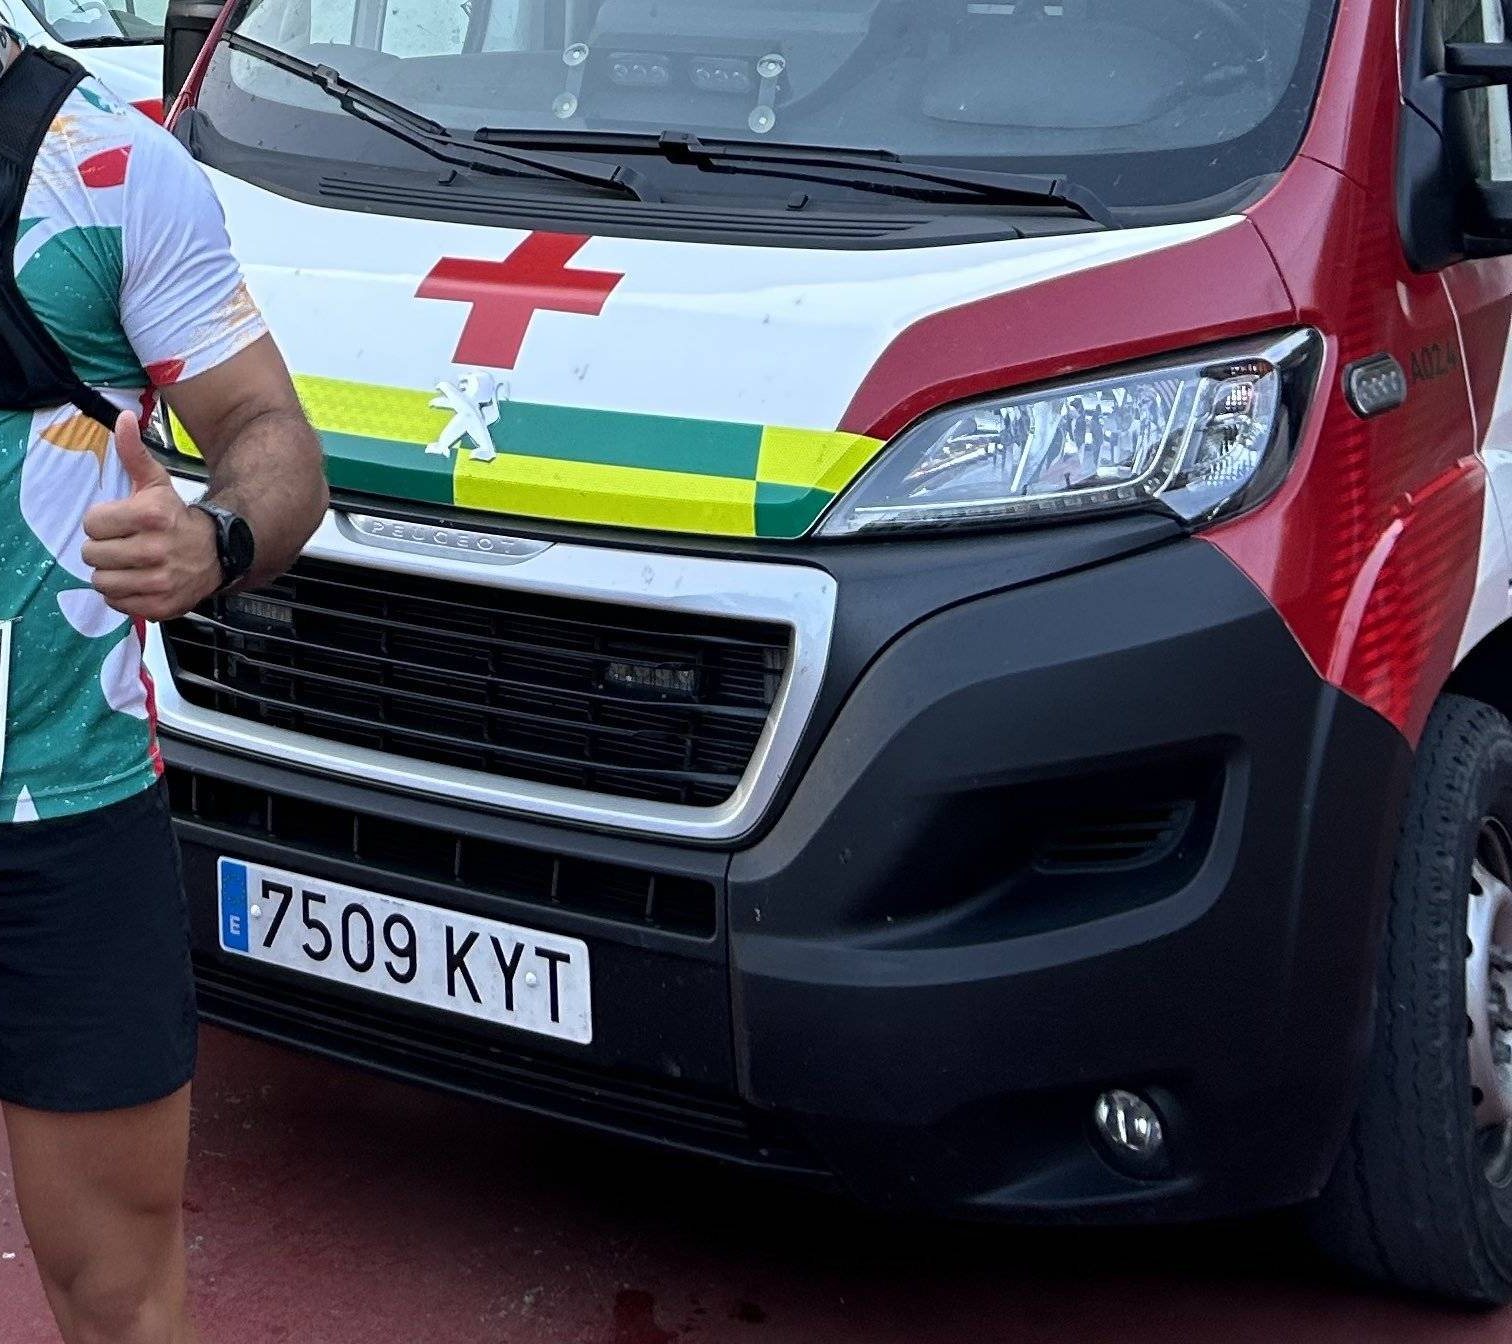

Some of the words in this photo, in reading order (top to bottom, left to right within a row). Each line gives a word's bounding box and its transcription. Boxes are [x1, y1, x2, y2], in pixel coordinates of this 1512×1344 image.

[371, 520, 516, 554] PEUGEOT
[229, 914, 241, 935] E
[261, 879, 418, 984] 7509
[445, 925, 571, 1023] KYT
